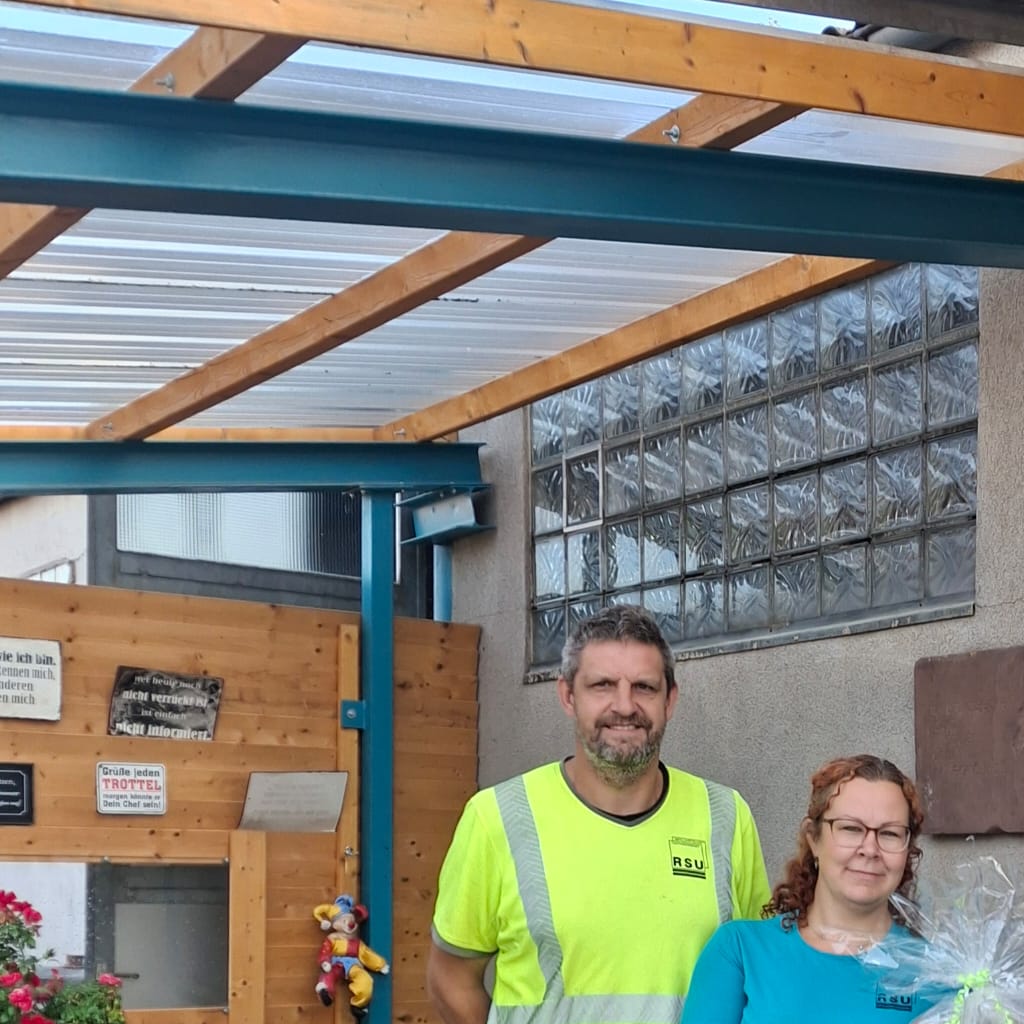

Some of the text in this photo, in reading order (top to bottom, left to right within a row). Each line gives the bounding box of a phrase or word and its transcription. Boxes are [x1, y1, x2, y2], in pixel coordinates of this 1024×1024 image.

[16, 651, 32, 665] ich
[0, 665, 29, 678] ennen
[0, 679, 33, 692] nderen
[122, 689, 149, 702] nicht
[115, 722, 145, 735] nicht
[102, 766, 160, 778] Grüße jeden
[102, 778, 161, 790] TROTTEL
[103, 800, 120, 808] Dein
[123, 800, 141, 808] Chef
[673, 856, 703, 870] RSU
